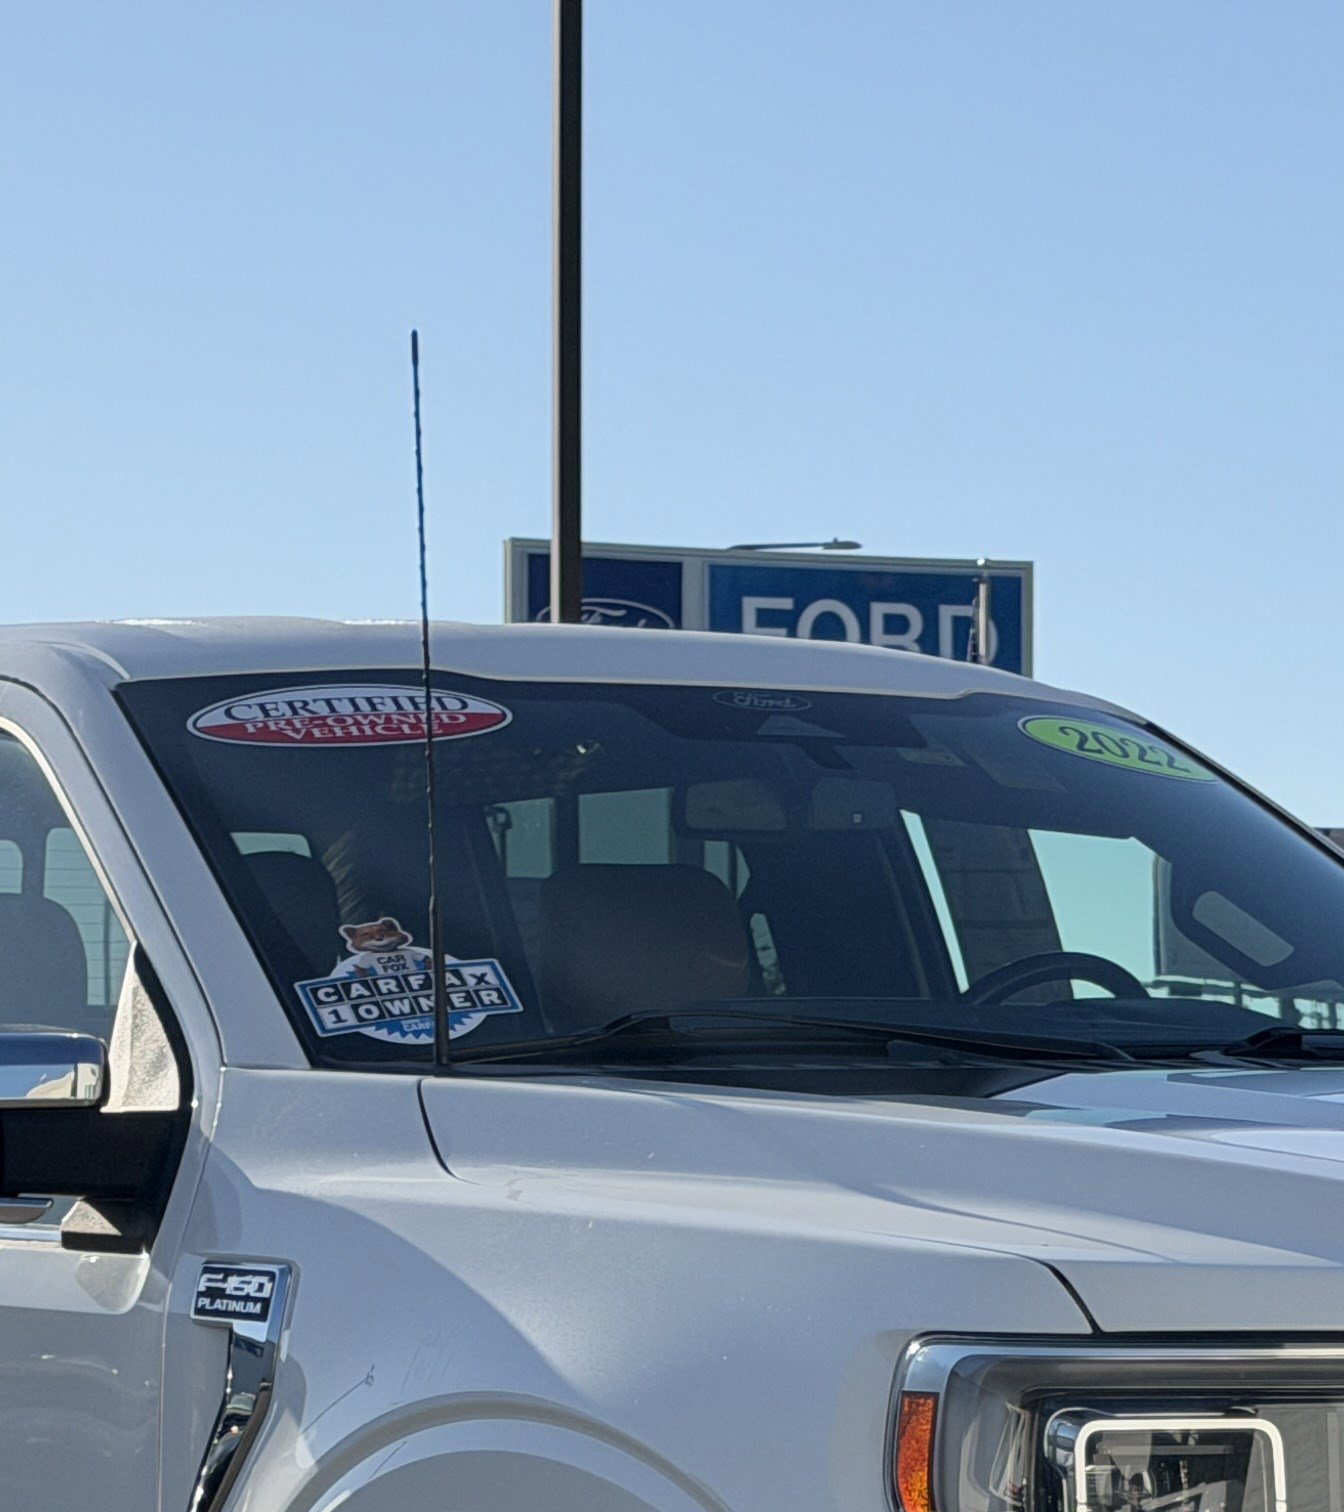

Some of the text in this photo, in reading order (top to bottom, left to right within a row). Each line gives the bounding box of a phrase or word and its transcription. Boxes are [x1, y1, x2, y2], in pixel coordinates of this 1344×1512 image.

[223, 695, 471, 722] CERTIFIED
[284, 722, 444, 740] VEHICLE
[1058, 725, 1193, 774] 2022
[376, 954, 407, 966] CAR
[381, 962, 410, 974] FOX
[316, 970, 491, 1004] CARFAX
[327, 989, 503, 1025] 1 OWNER
[197, 1297, 262, 1314] PLATINUM
